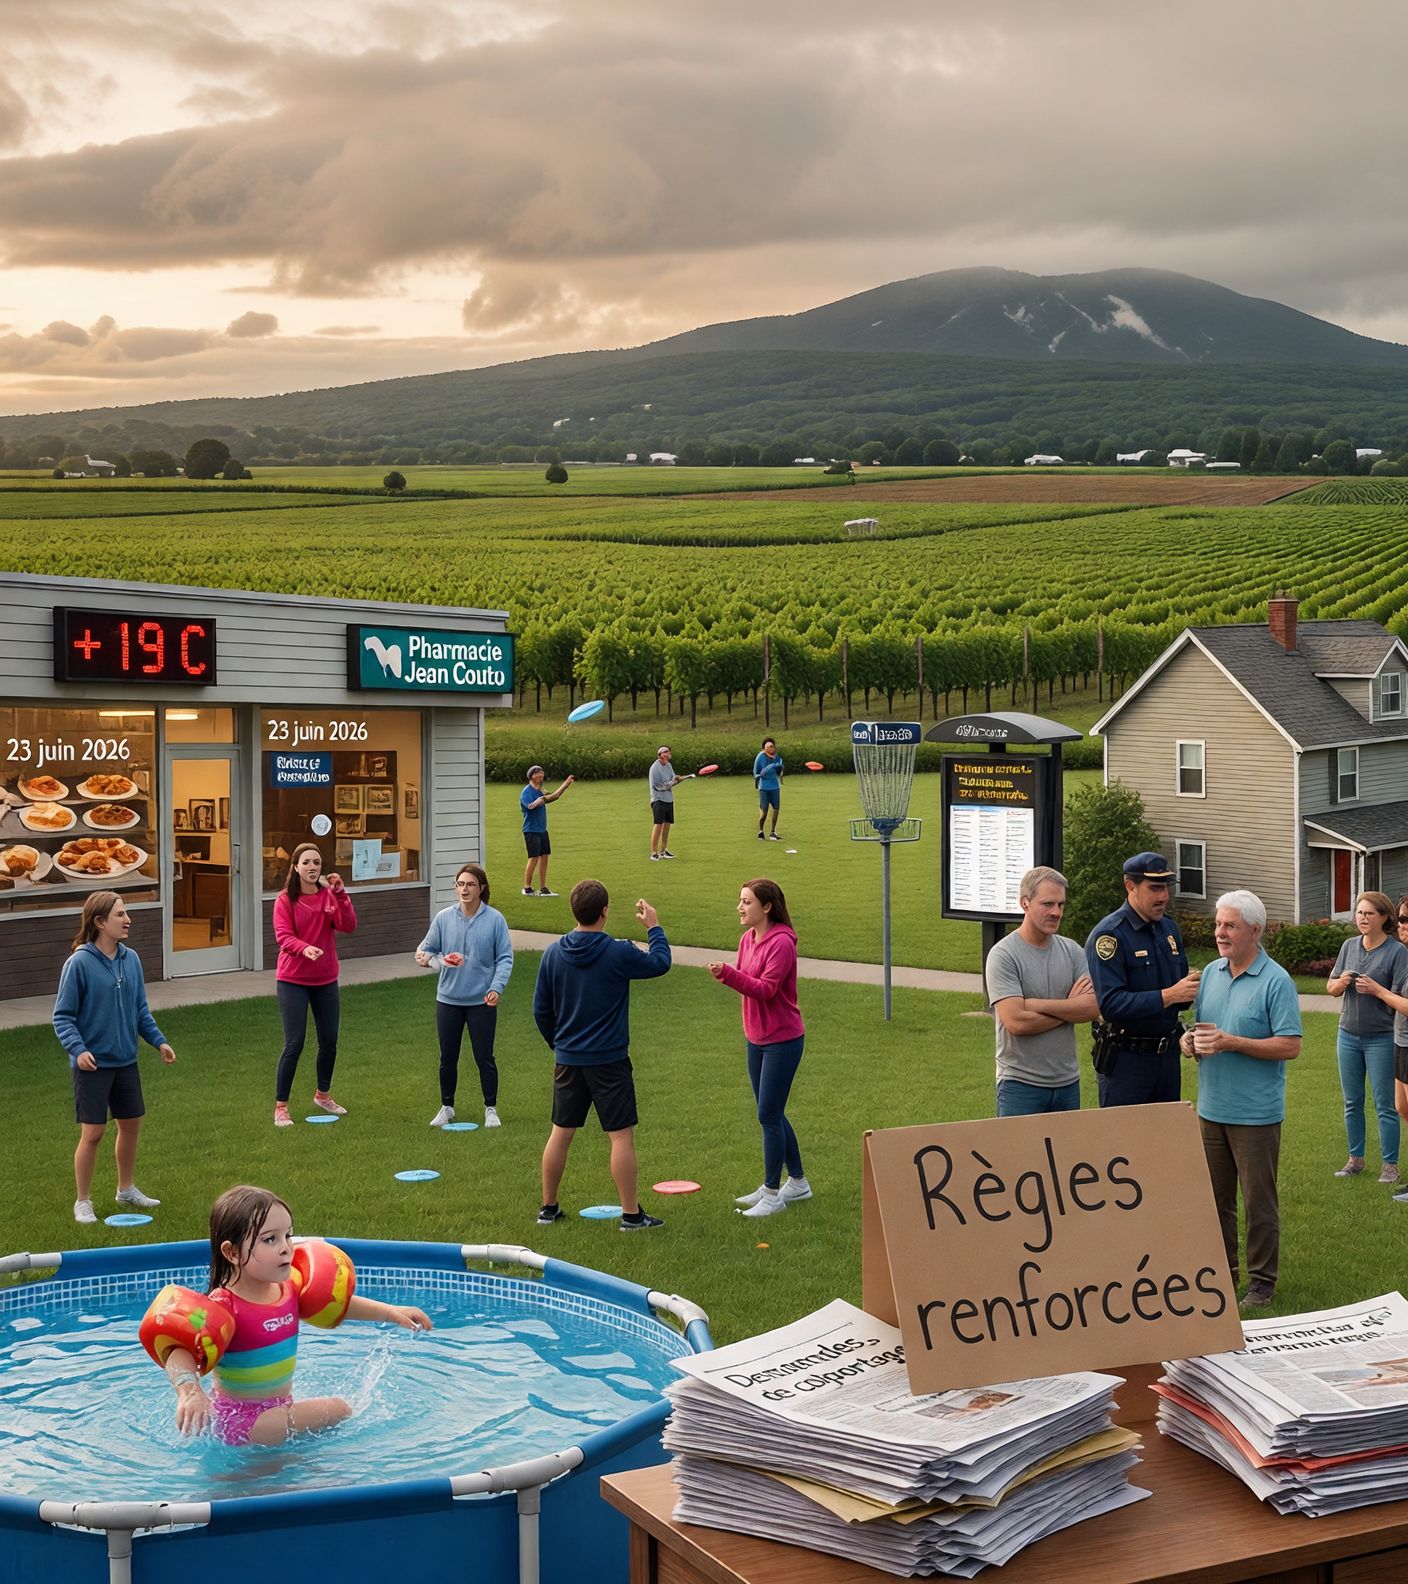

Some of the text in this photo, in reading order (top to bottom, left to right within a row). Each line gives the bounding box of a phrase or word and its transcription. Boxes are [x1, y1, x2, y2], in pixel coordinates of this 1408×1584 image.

[409, 635, 502, 661] Pharmacie
[404, 661, 449, 684] Jean
[268, 720, 368, 747] 23 juin 2026
[7, 738, 130, 768] 23 juin 2026
[912, 1137, 1143, 1253] Règles
[916, 1254, 1227, 1350] renforcées
